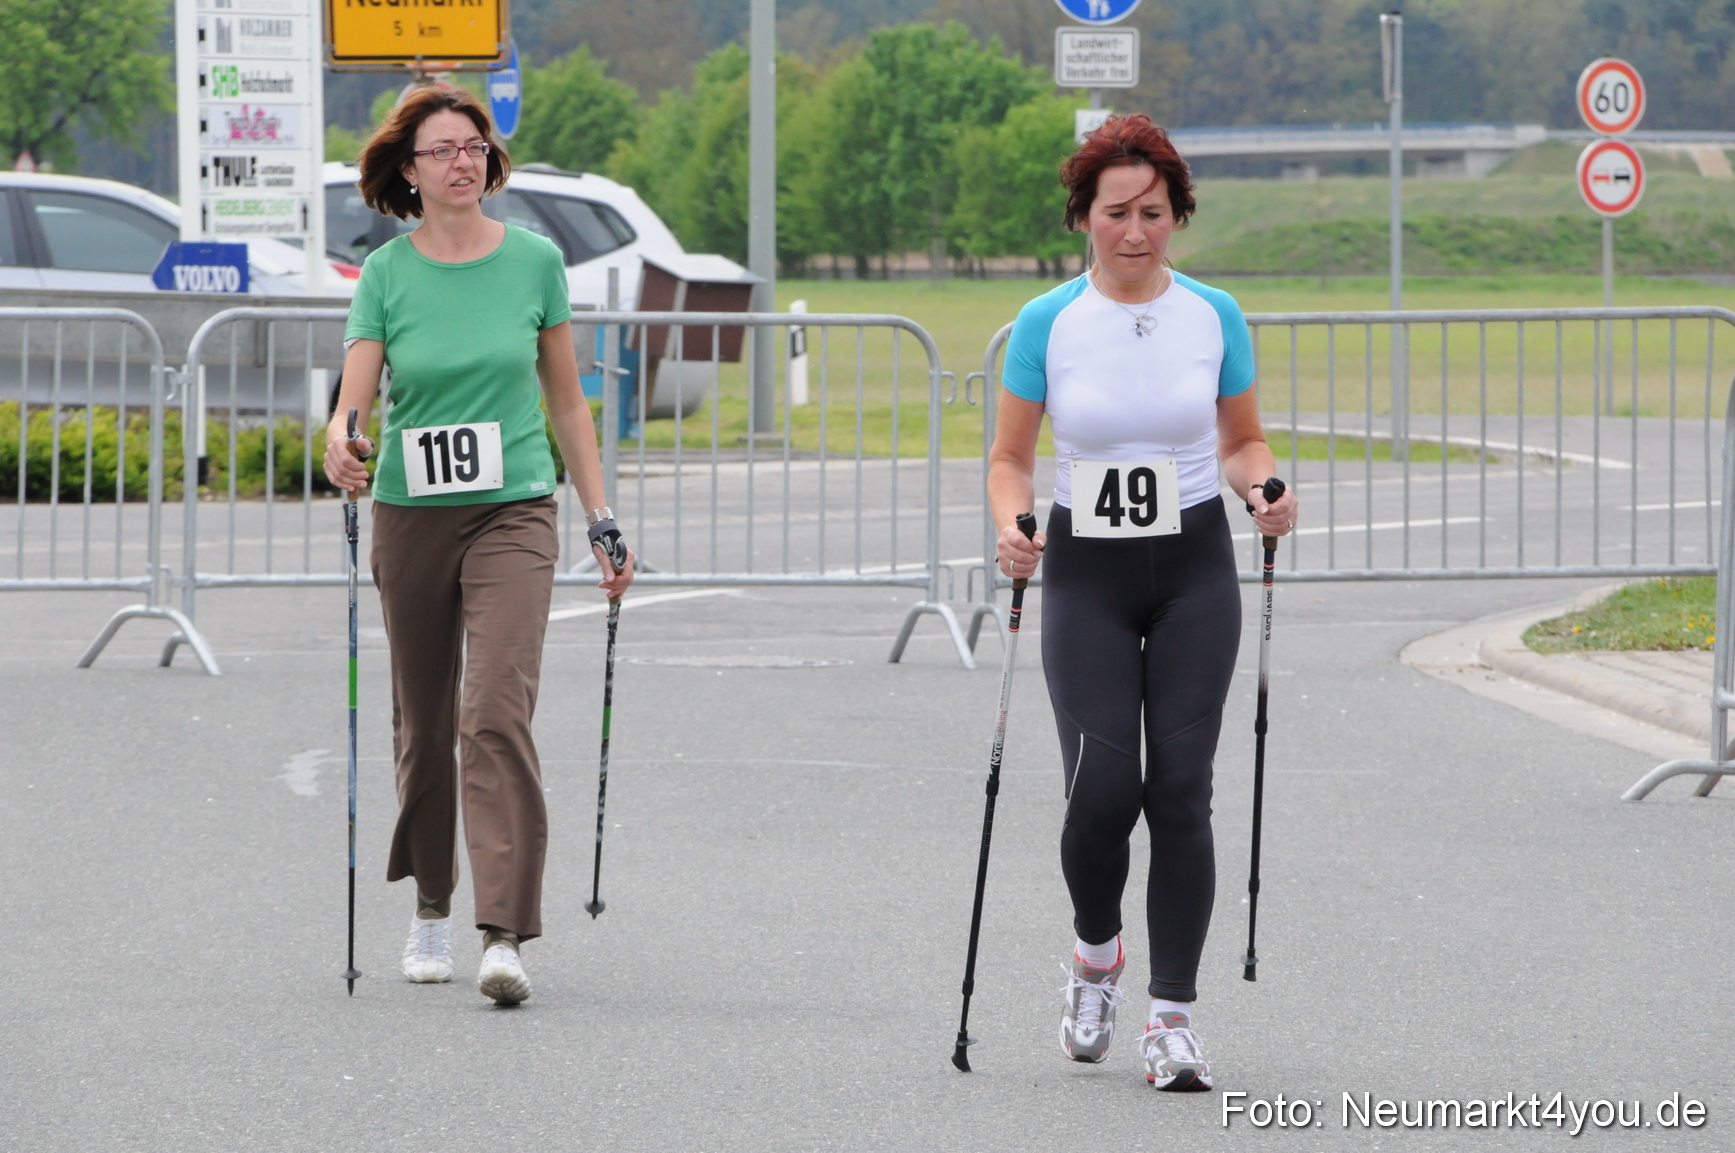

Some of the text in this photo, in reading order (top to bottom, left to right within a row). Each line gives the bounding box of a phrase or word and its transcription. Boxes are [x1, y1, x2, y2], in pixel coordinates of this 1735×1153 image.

[393, 20, 443, 37] 5 km
[1071, 37, 1124, 49] Landwirt-
[1065, 52, 1128, 63] schaftlicher
[1065, 67, 1128, 78] Verkehr frei
[1595, 81, 1629, 113] 60
[172, 265, 241, 292] VOLVO
[418, 427, 480, 485] 119
[1095, 467, 1158, 527] 49
